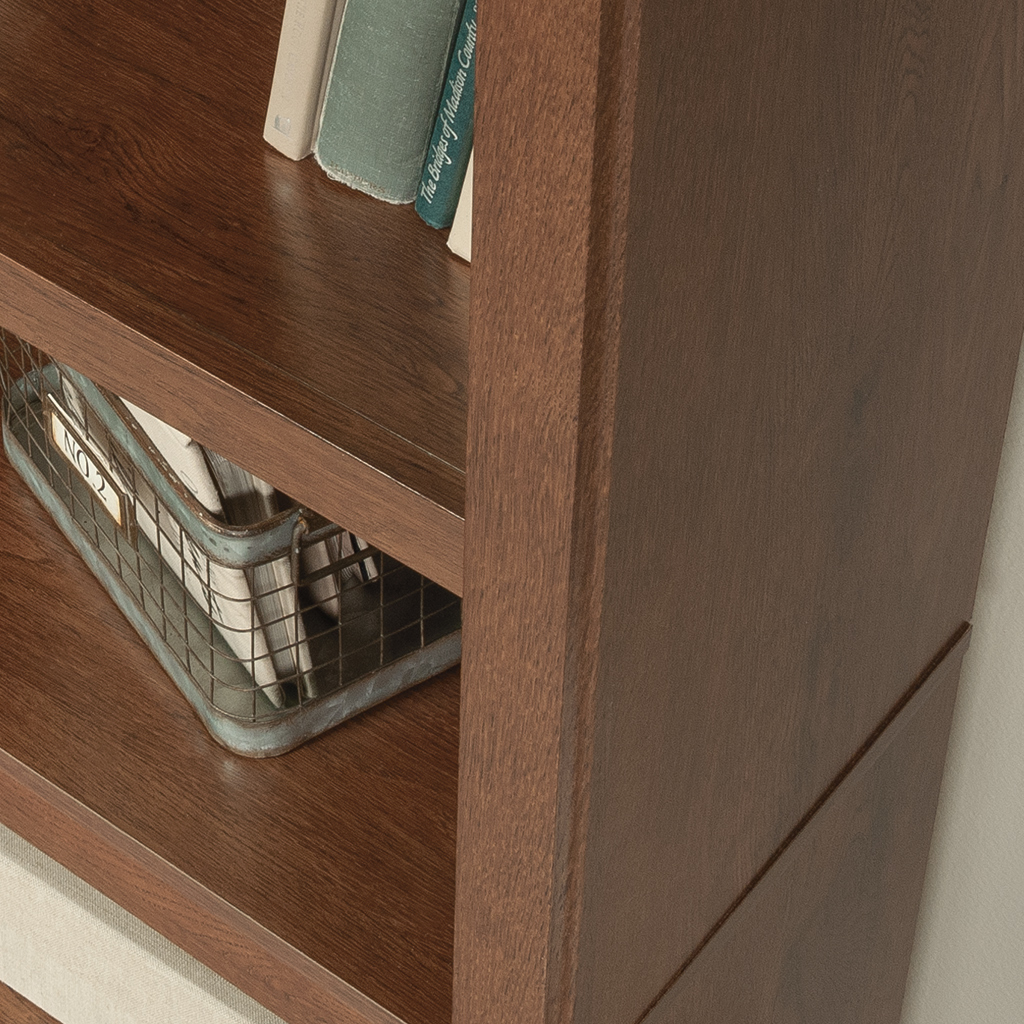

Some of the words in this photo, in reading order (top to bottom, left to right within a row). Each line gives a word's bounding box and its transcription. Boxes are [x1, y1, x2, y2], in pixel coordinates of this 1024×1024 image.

[443, 68, 468, 124] Madison
[440, 113, 458, 141] of
[427, 134, 453, 182] Bridges
[420, 179, 437, 205] The
